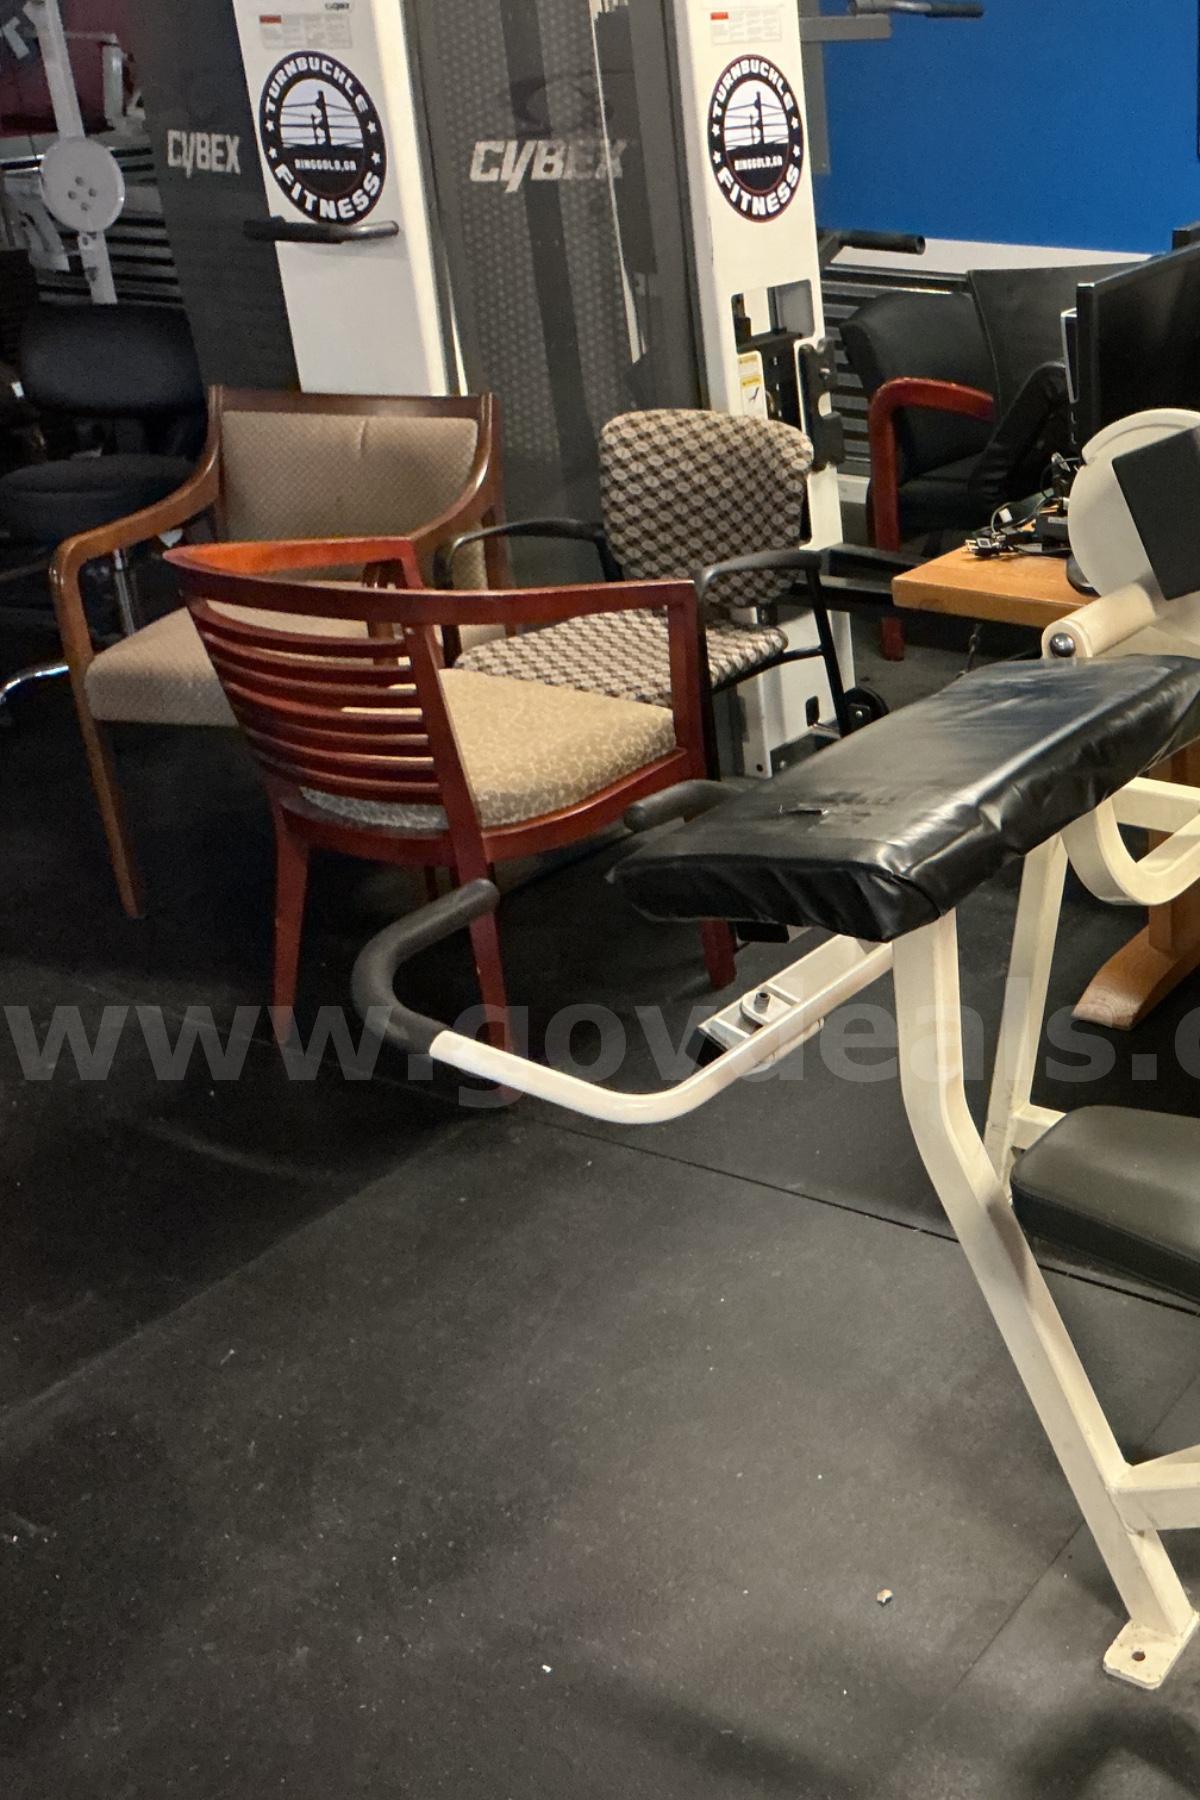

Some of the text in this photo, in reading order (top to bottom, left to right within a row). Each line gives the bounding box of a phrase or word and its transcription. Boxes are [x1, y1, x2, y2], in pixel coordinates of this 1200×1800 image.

[166, 129, 241, 179] CYBEX
[275, 163, 380, 220] FITNESS
[717, 163, 799, 216] FITNESS
